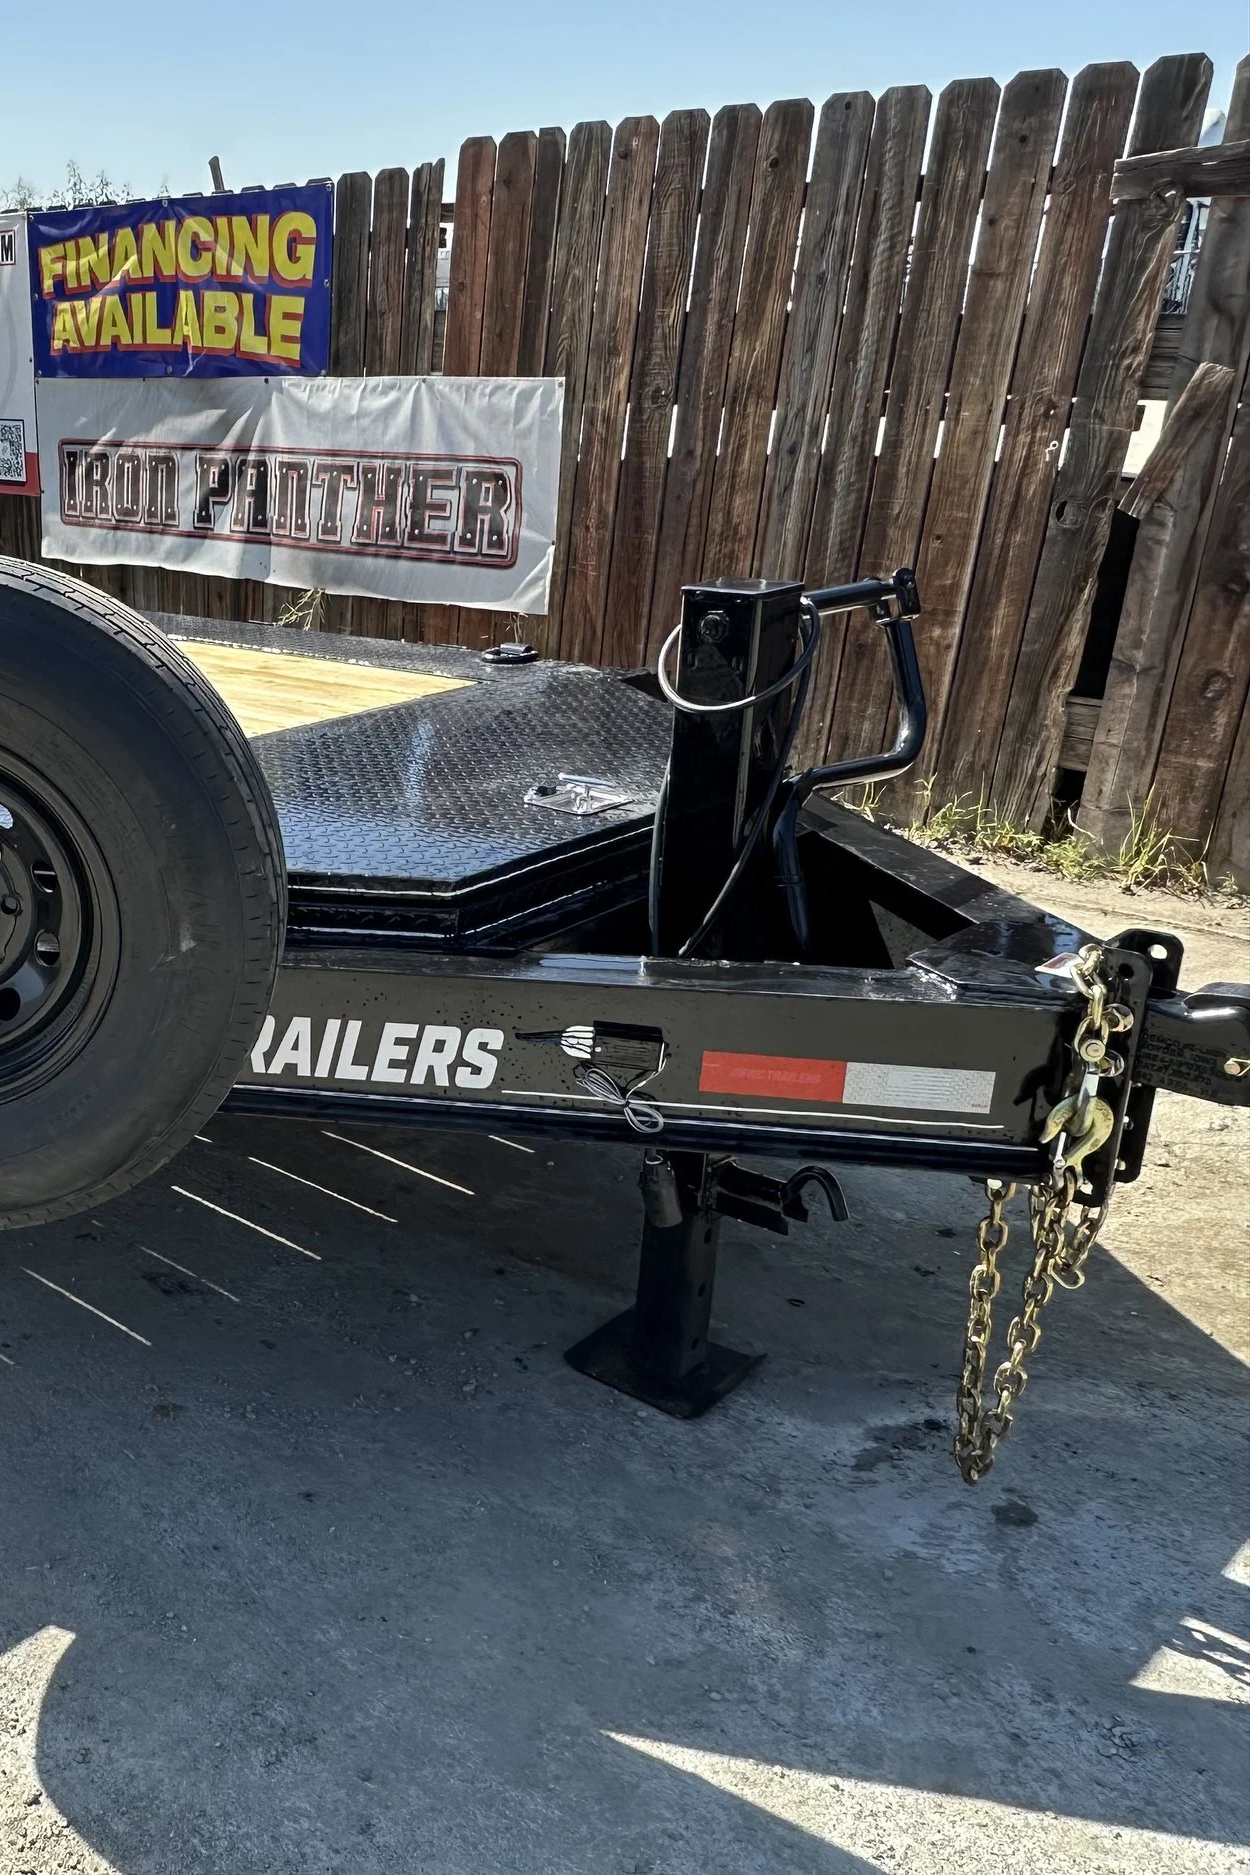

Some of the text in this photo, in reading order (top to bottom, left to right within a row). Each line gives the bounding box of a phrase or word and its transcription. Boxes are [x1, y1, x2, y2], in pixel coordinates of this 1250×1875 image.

[38, 212, 317, 298] FINANCING
[50, 289, 306, 367] AVAILABLE
[64, 447, 512, 556] IRON PANTHER
